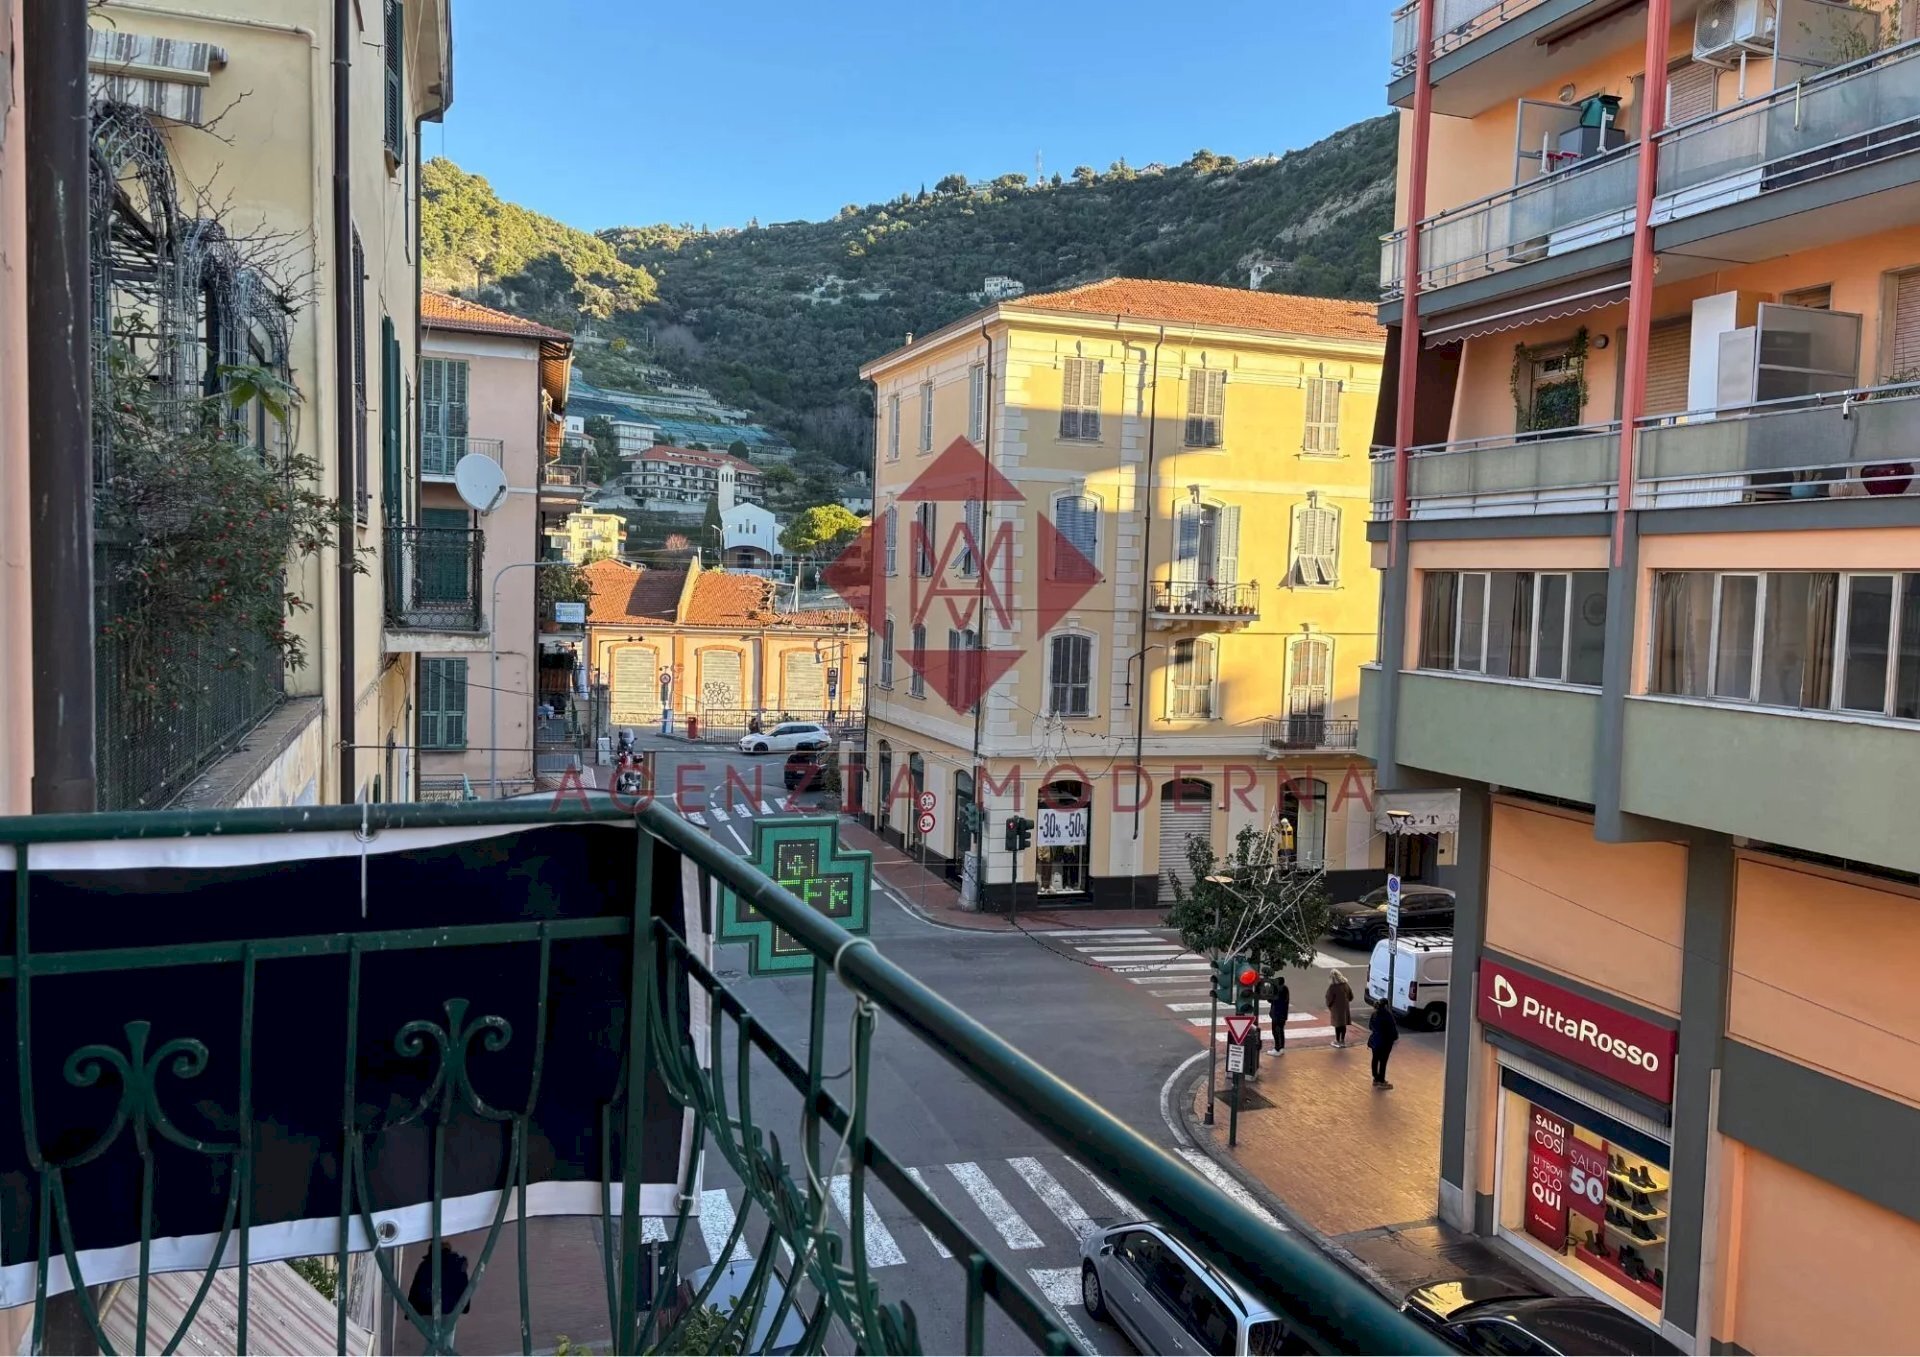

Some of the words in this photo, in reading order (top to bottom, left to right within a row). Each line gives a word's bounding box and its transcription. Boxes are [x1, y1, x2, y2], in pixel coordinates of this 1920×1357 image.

[1039, 813, 1061, 838] -30%
[1065, 813, 1086, 838] -50%
[1522, 996, 1659, 1072] PittaRosso
[1535, 1114, 1565, 1138] SALDI
[1532, 1166, 1562, 1192] SOLO
[1542, 1159, 1563, 1178] TROVI
[1570, 1149, 1606, 1181] SALDI
[1532, 1181, 1561, 1211] QUI
[1570, 1166, 1604, 1205] 50
